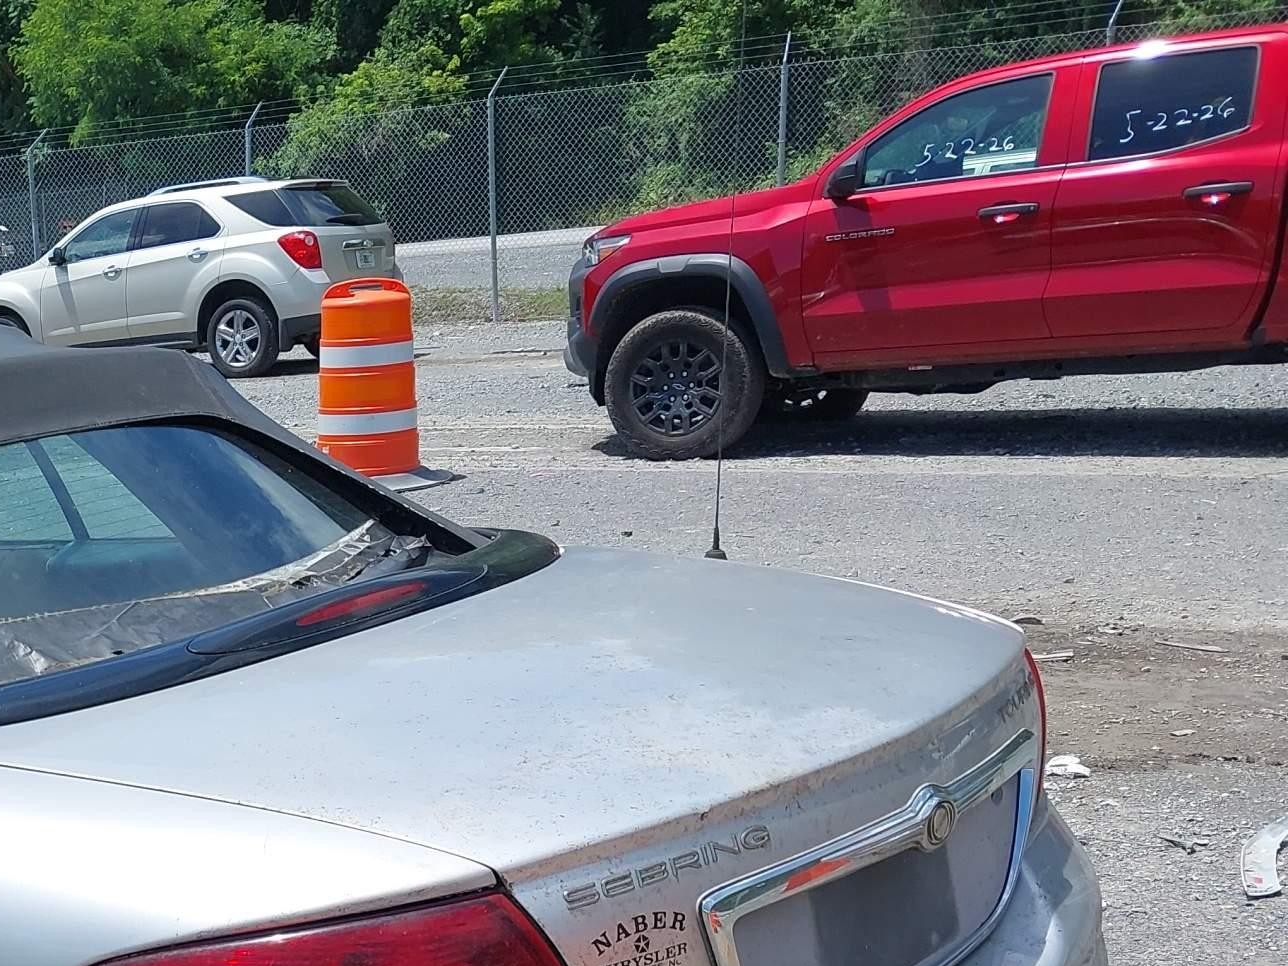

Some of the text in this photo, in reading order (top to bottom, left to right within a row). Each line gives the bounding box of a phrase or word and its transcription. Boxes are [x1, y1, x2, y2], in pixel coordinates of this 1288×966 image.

[1119, 96, 1236, 143] 5-22-26
[824, 227, 896, 242] COLORADO
[562, 824, 772, 911] SEBRING
[591, 911, 687, 957] NABER
